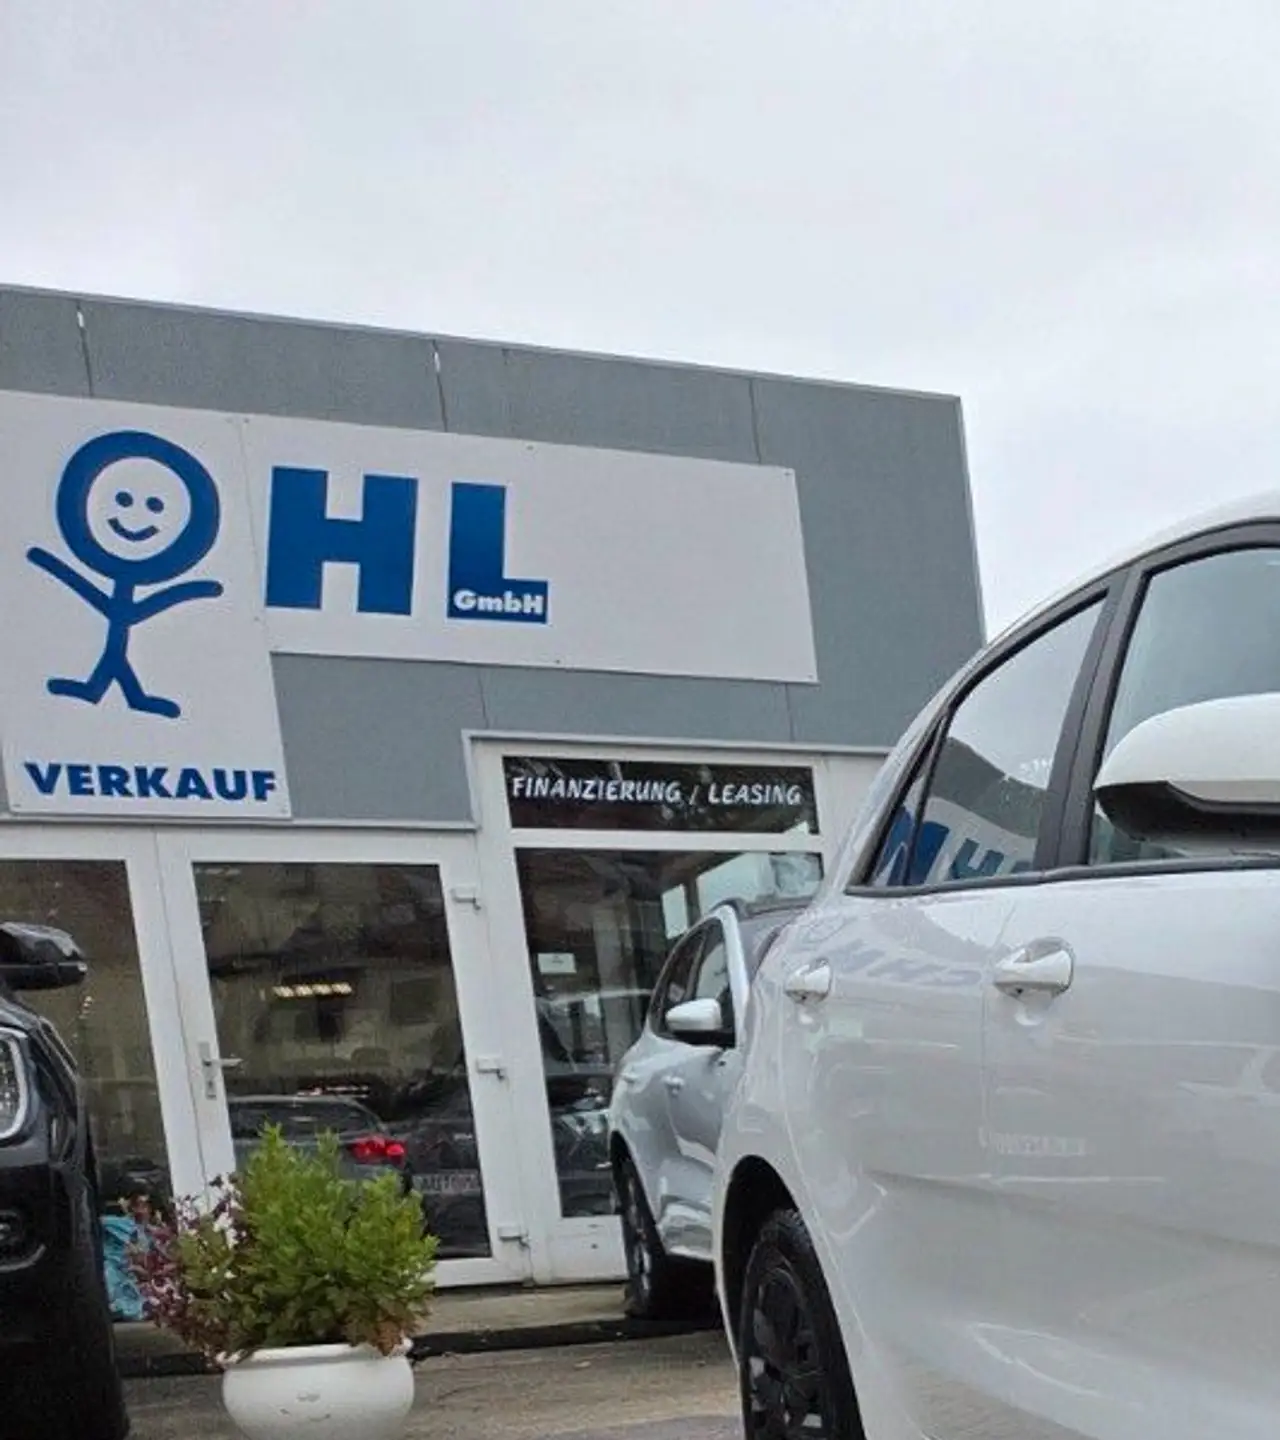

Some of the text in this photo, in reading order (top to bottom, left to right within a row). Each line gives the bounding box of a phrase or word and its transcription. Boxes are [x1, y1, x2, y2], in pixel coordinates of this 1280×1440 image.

[453, 588, 544, 615] GmbH
[25, 761, 278, 803] VERKAUF
[511, 777, 681, 801] FINANZIERUNG
[708, 782, 802, 806] LEASING
